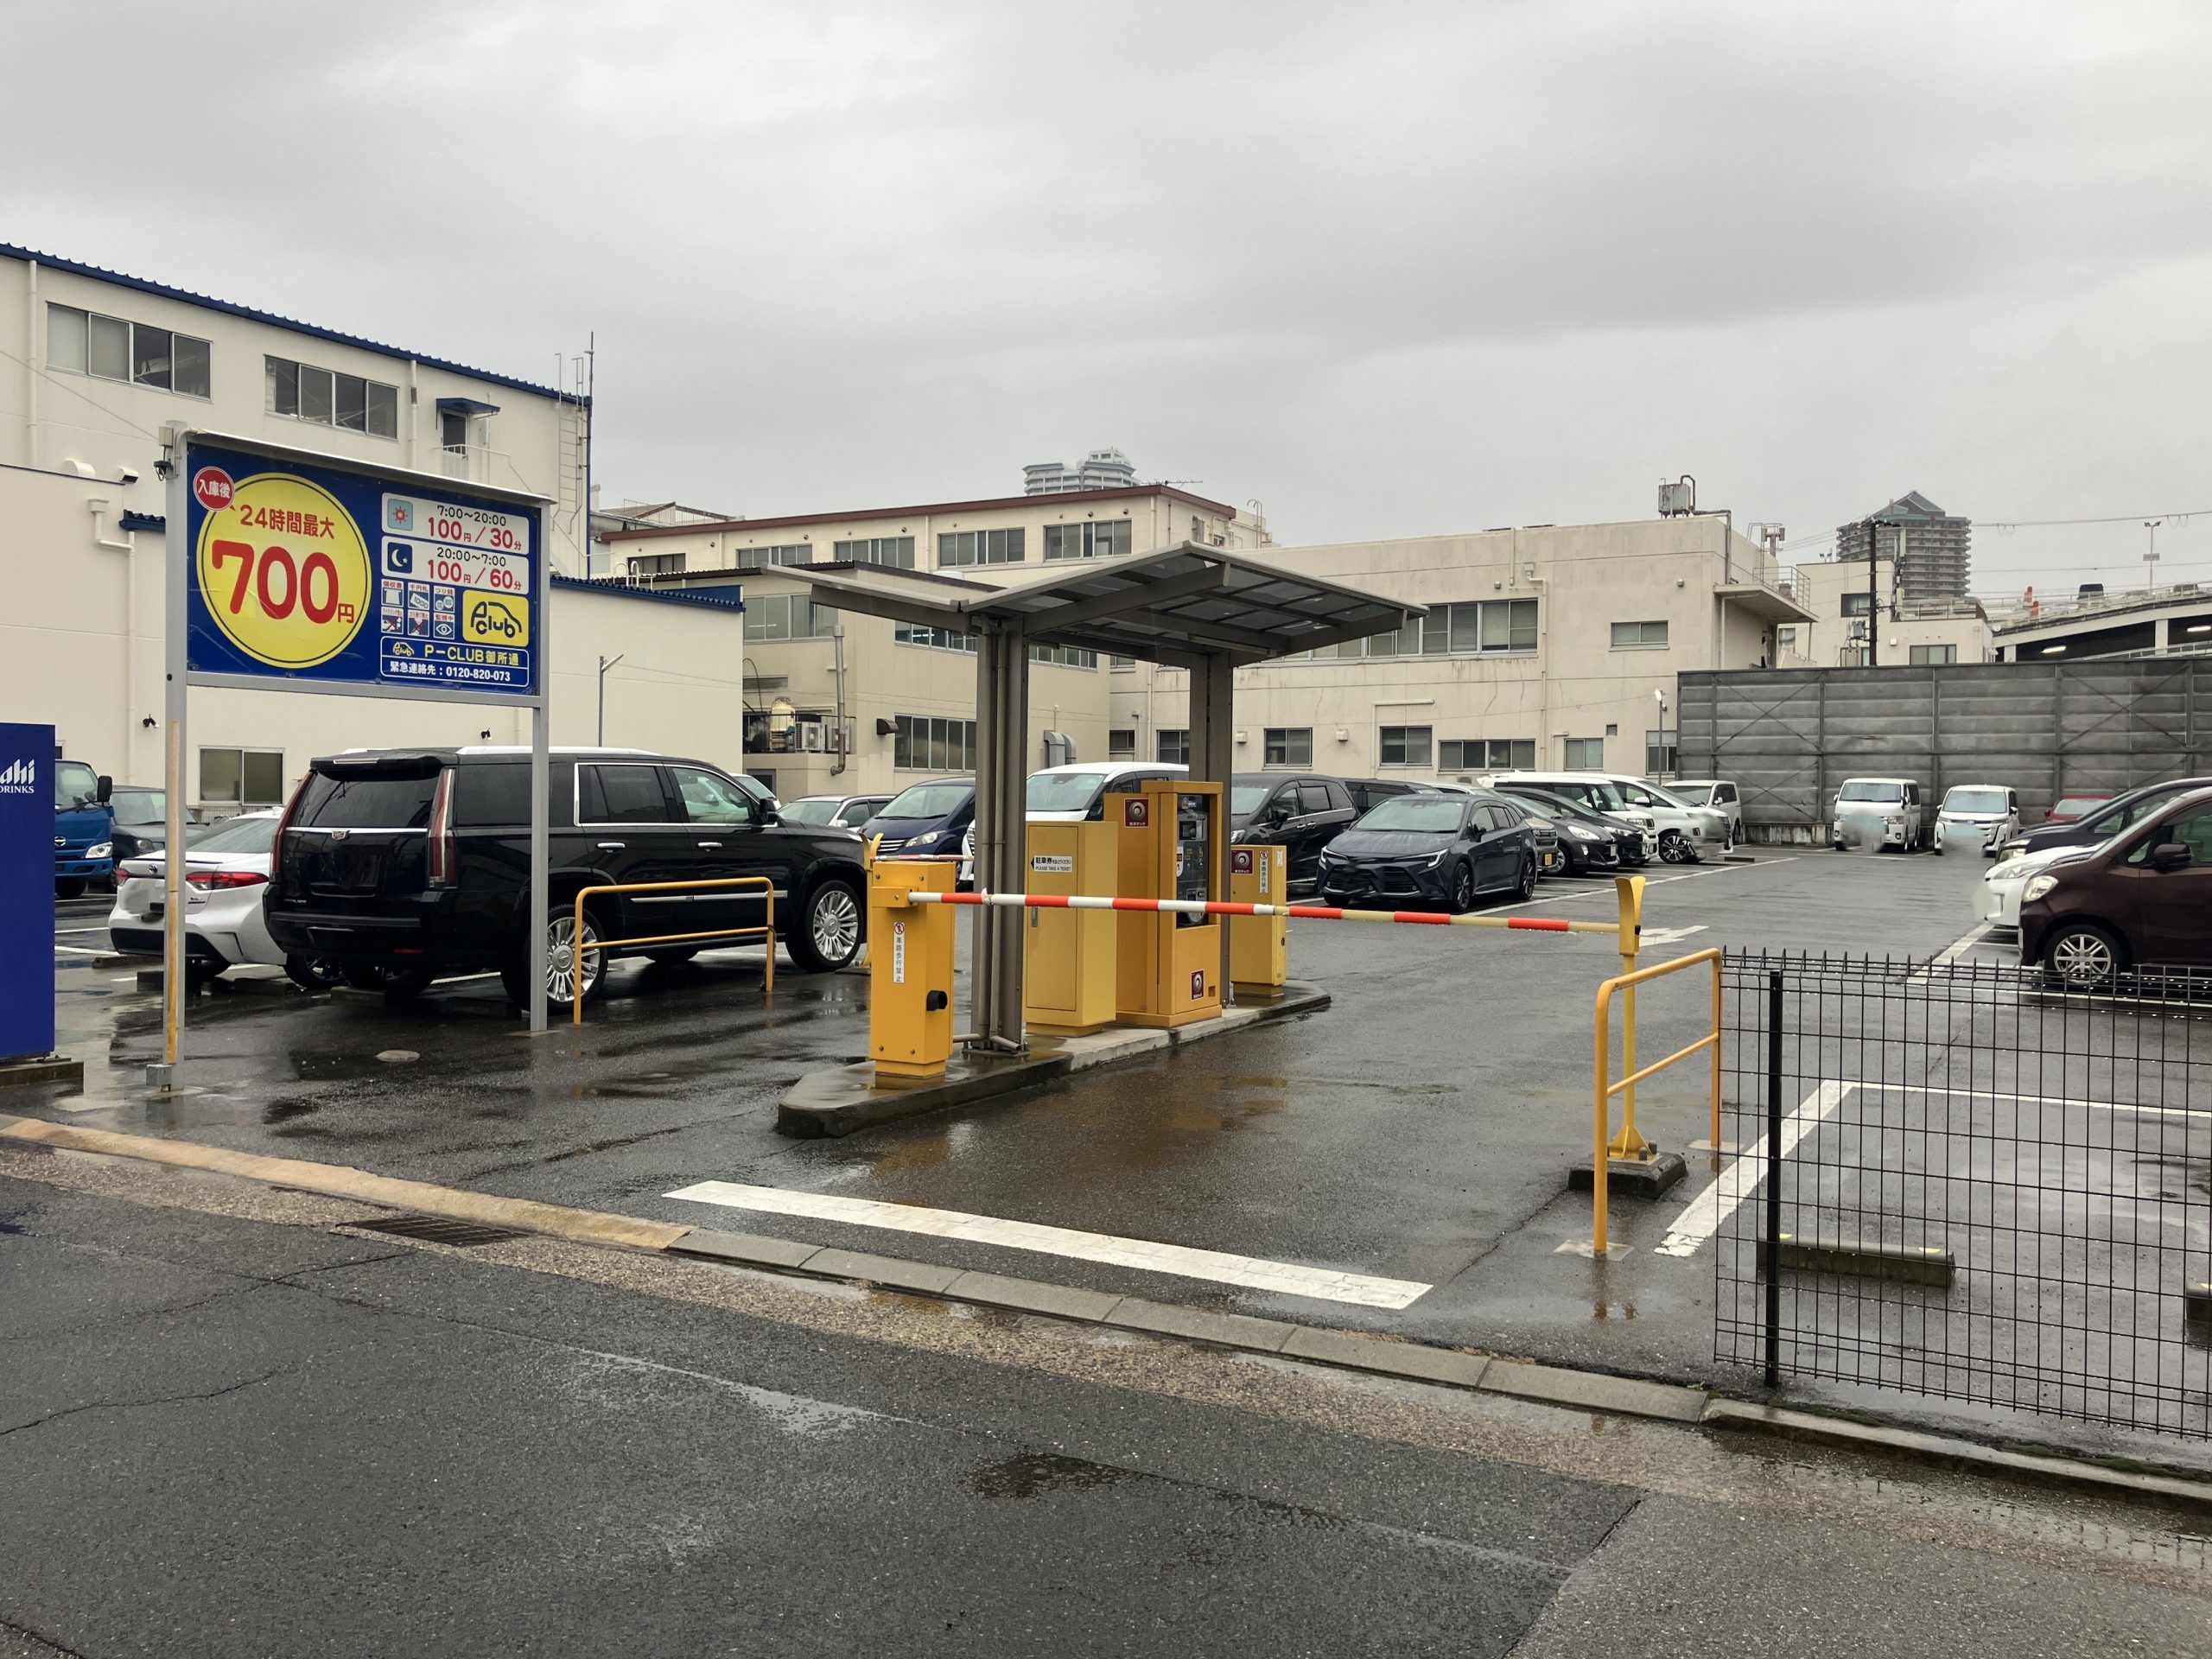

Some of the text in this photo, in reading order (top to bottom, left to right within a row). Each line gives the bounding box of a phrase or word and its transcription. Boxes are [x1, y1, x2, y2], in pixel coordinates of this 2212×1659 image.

[198, 479, 231, 499] 入庫後
[240, 504, 335, 540] 24時間最大
[212, 539, 355, 624] 700円
[410, 583, 429, 593] 千円札
